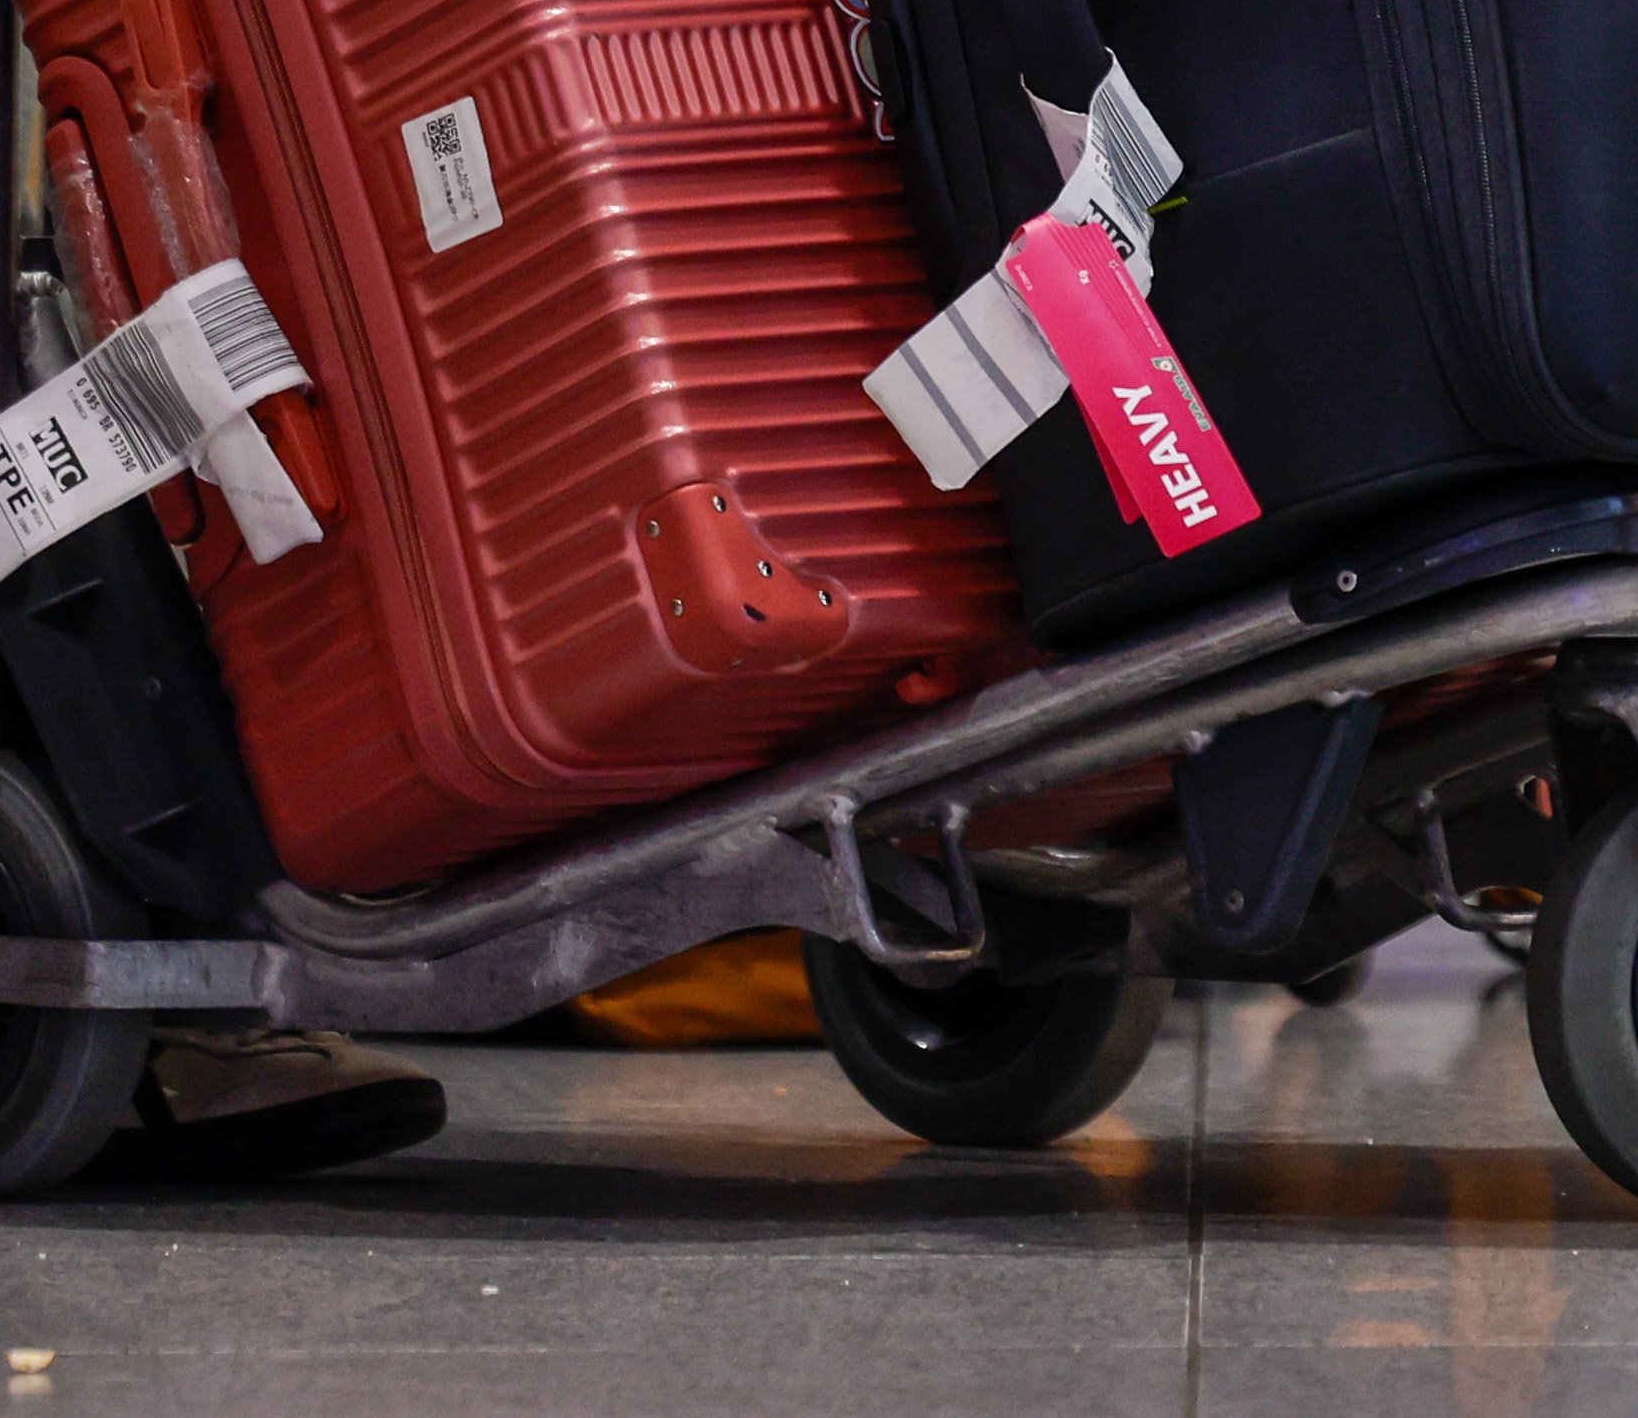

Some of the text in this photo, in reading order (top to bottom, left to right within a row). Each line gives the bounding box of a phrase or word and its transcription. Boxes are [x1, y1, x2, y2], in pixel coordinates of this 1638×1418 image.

[27, 418, 83, 493] MUC
[74, 375, 137, 474] 0 695 BR 573790
[1111, 381, 1218, 529] HEAVY
